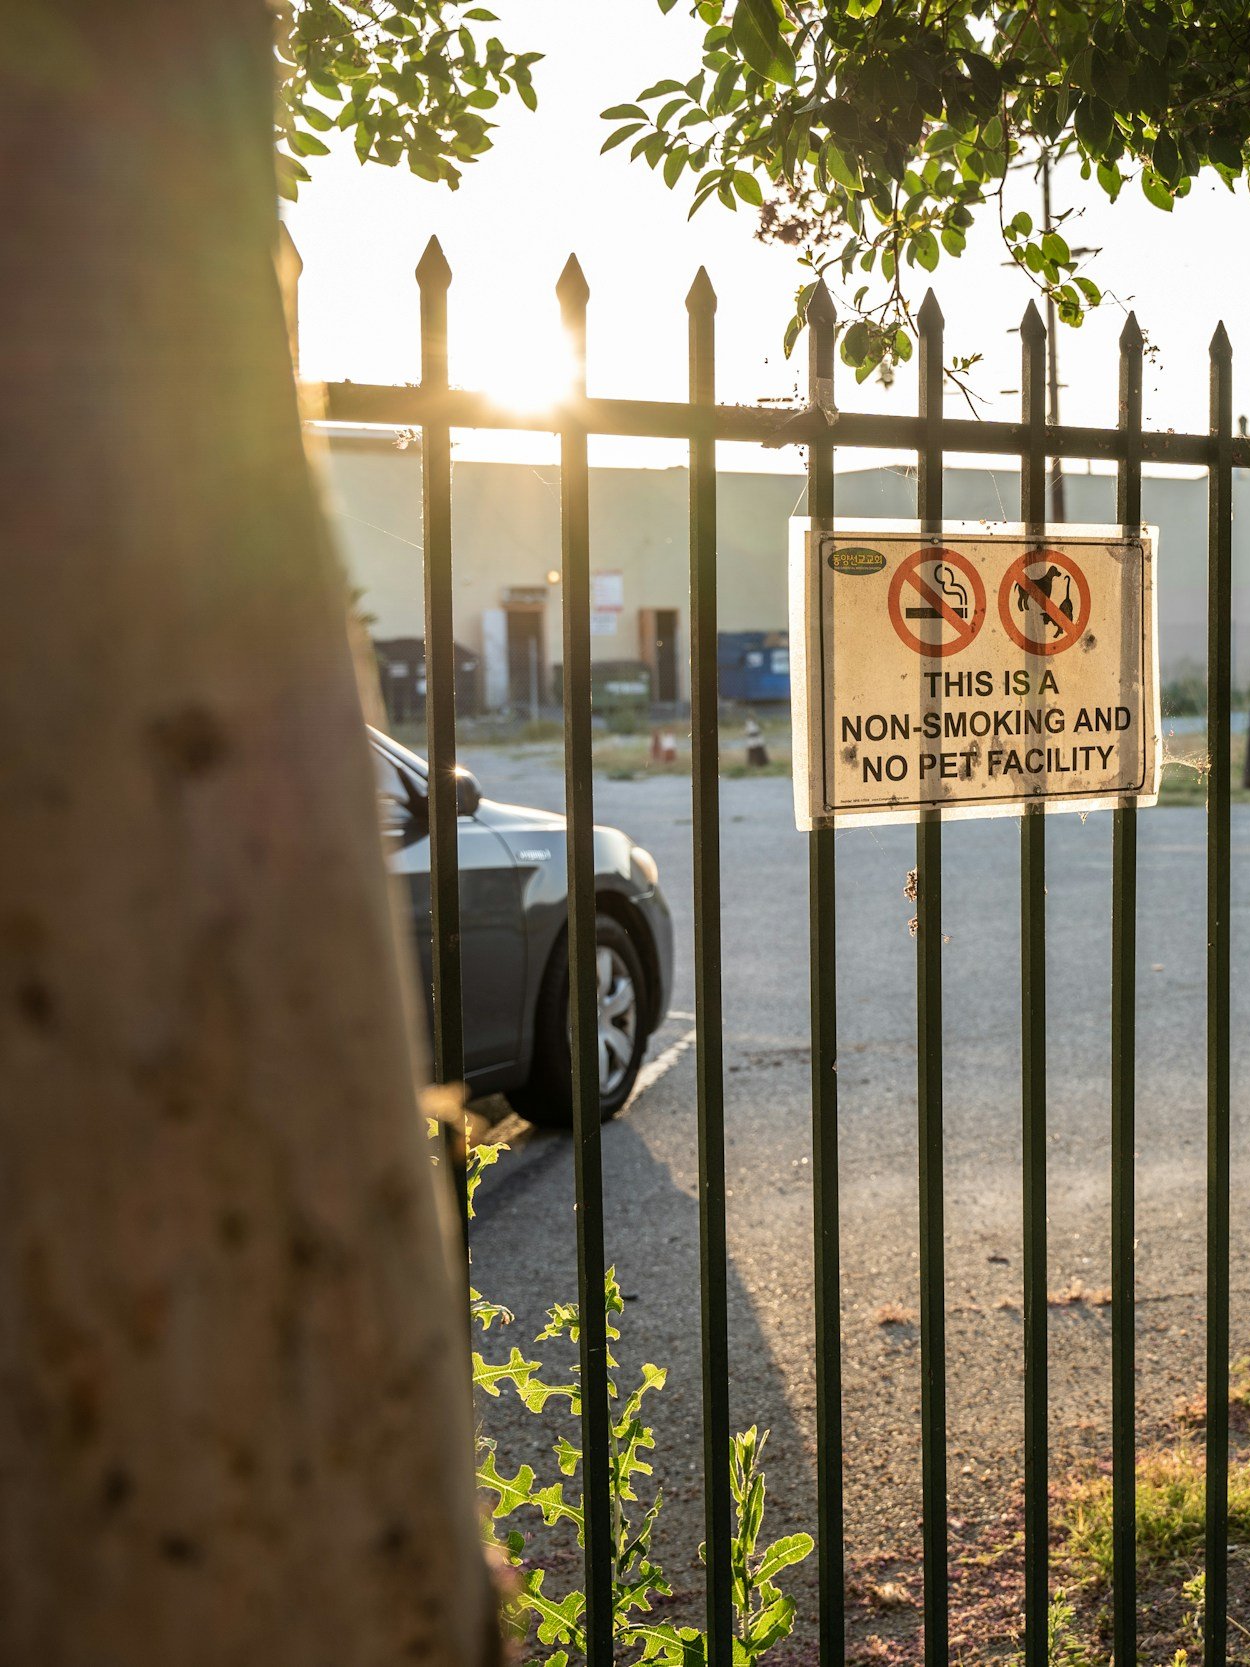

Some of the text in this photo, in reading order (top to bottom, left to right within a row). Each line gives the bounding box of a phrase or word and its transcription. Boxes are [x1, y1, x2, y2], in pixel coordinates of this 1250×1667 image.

[924, 669, 1060, 698] THIS IS A
[841, 706, 1131, 742] NON-SMOKING AND
[862, 745, 1115, 783] NO PET FACILITY
